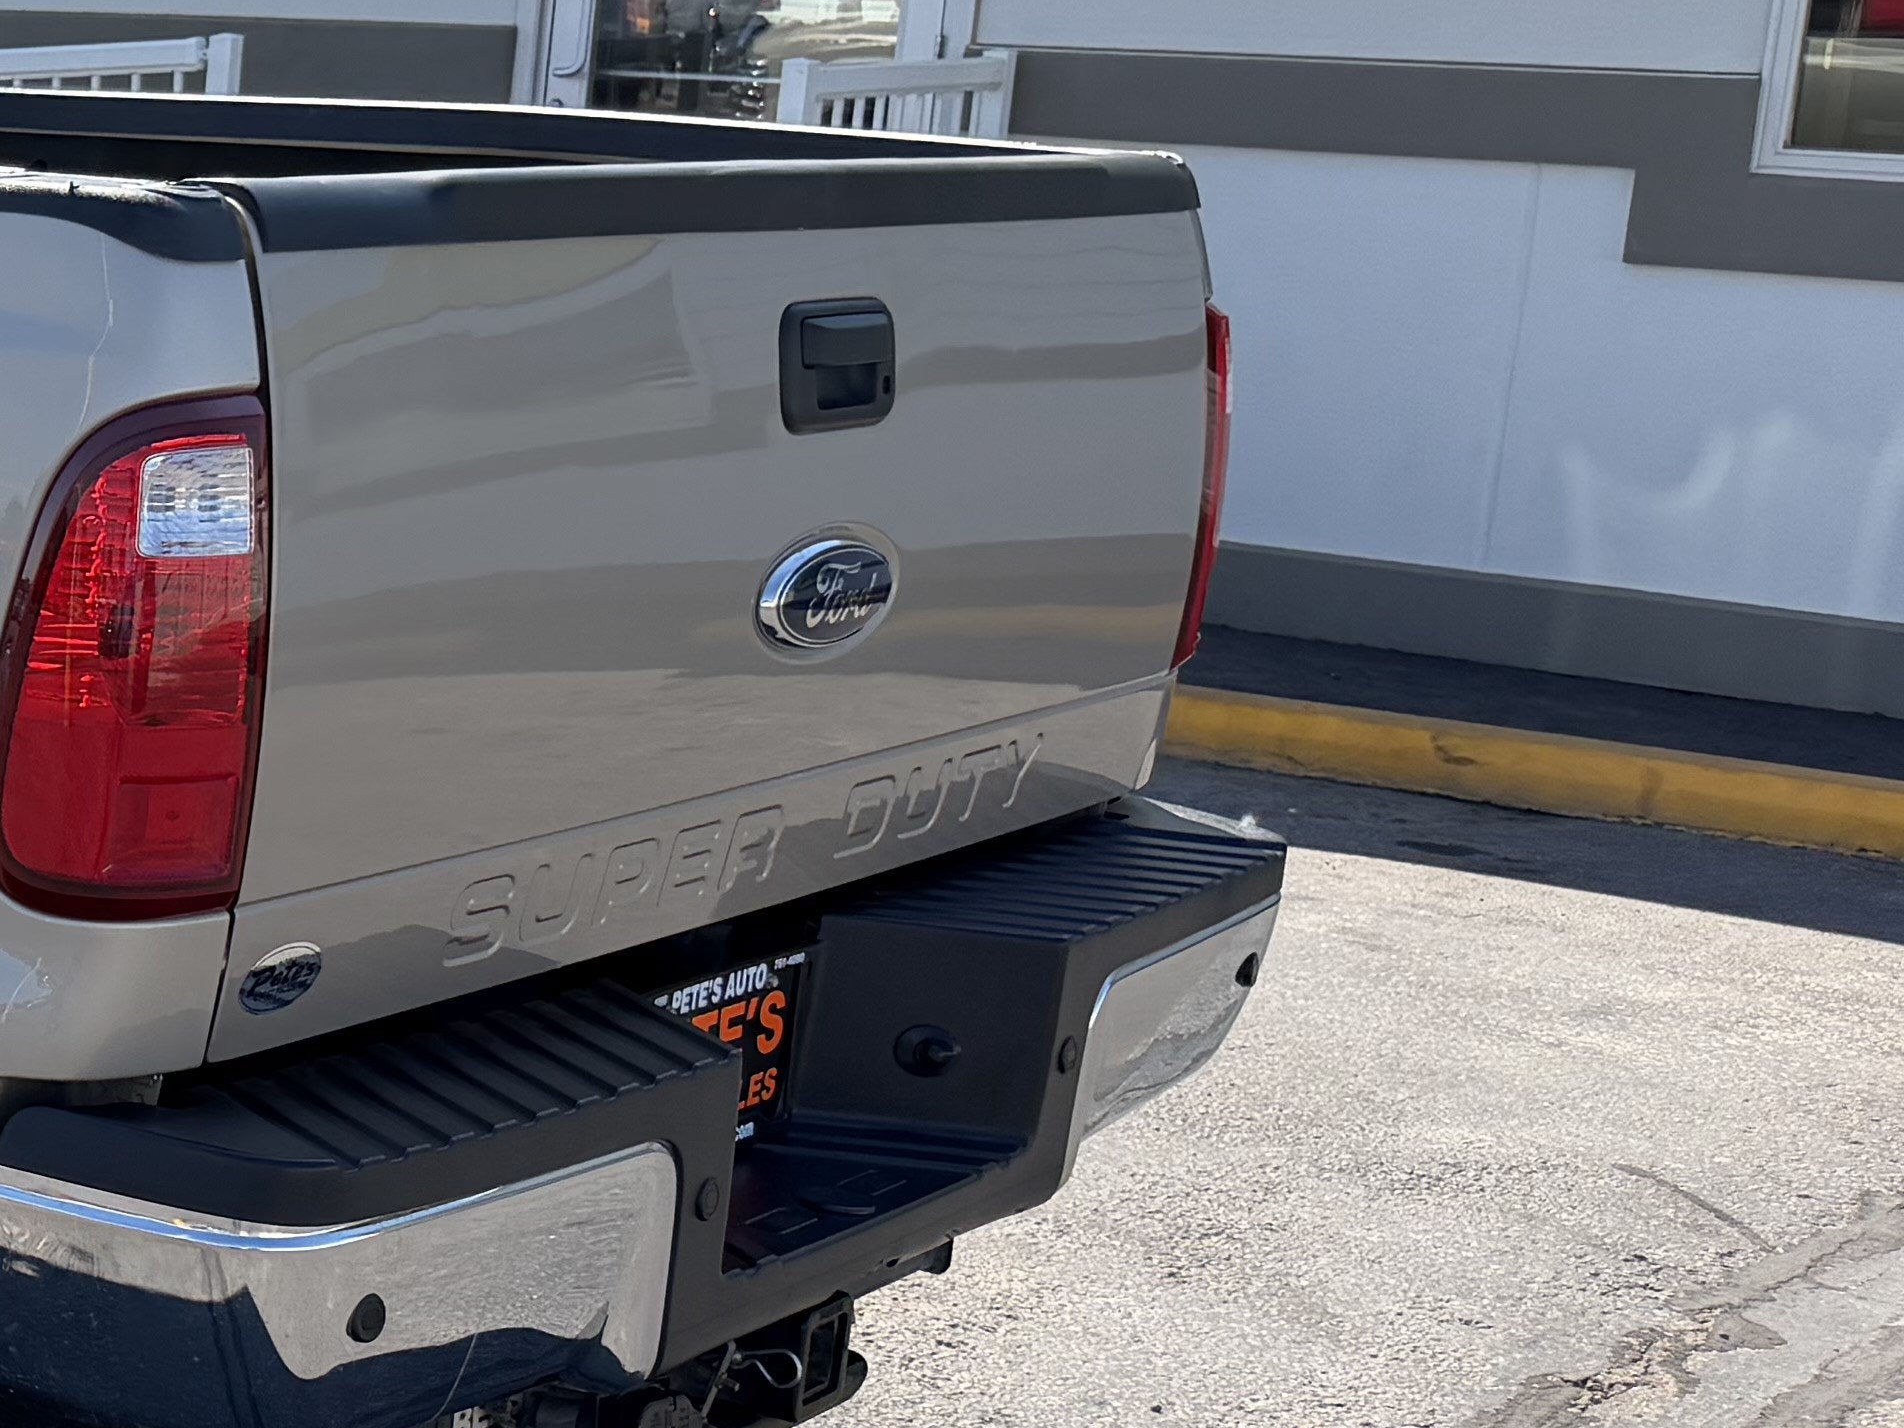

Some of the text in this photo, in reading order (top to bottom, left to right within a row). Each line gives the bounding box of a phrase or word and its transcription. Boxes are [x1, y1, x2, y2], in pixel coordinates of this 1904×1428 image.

[805, 561, 878, 629] Ford
[442, 732, 1045, 967] SUPER DUTY
[671, 962, 768, 1015] PETE'S AUTO
